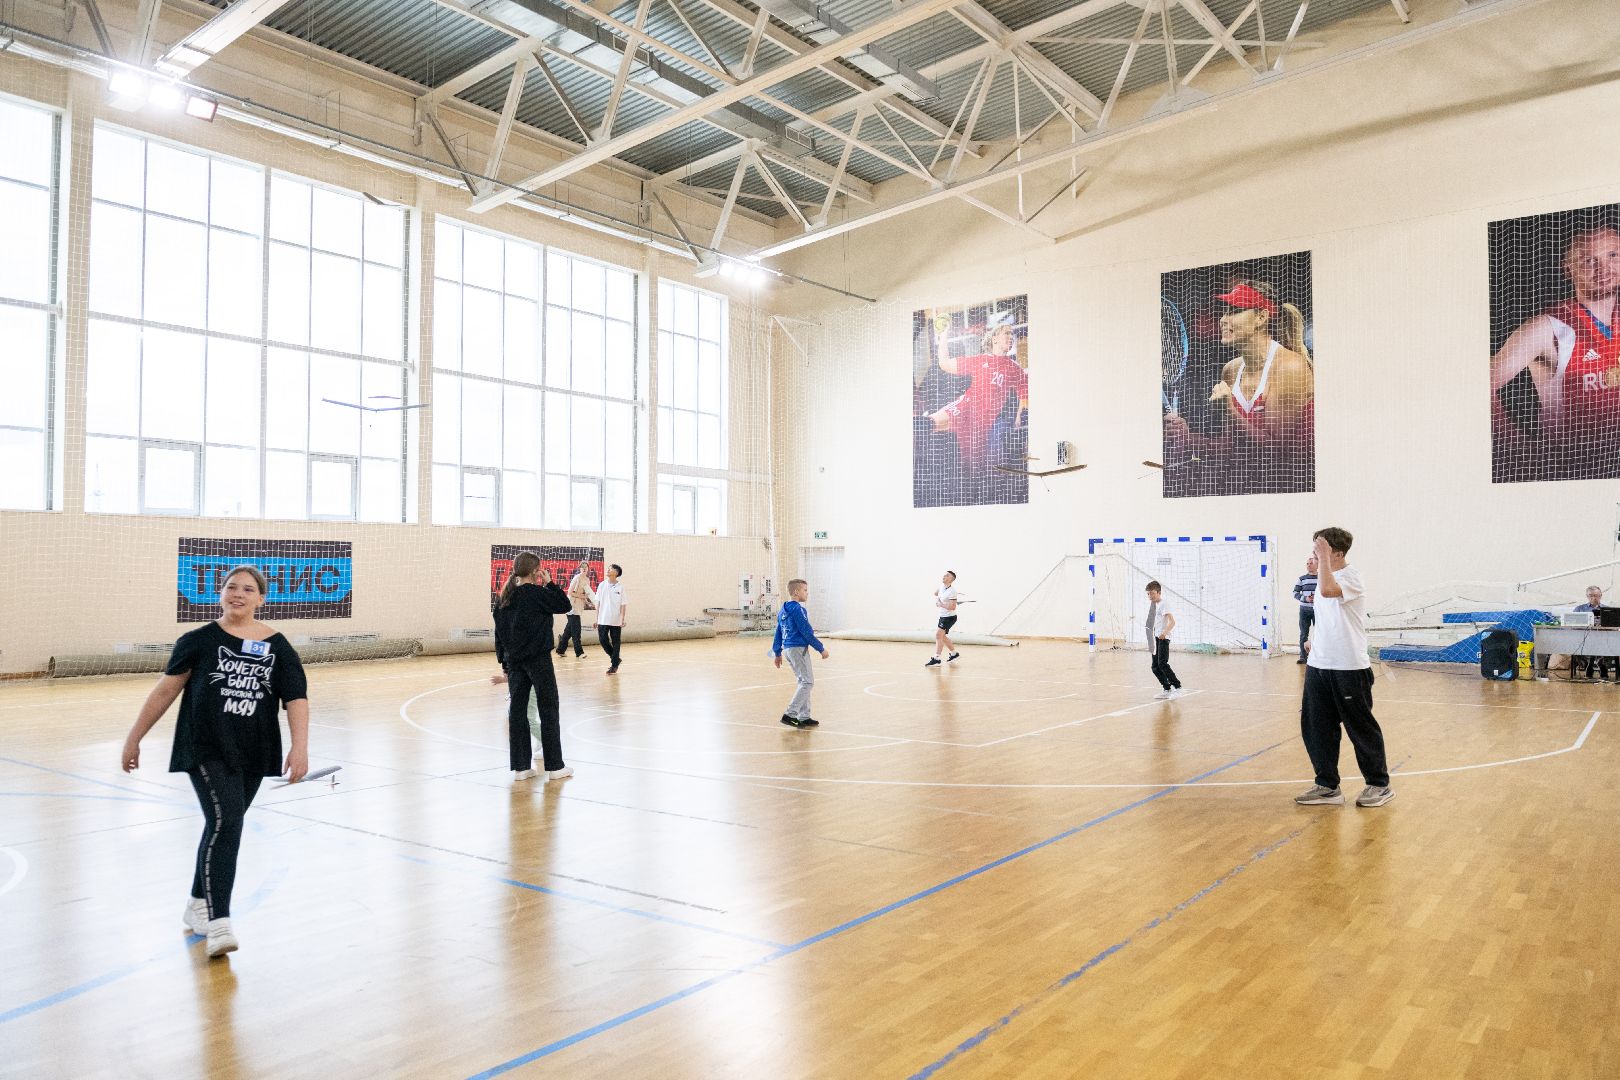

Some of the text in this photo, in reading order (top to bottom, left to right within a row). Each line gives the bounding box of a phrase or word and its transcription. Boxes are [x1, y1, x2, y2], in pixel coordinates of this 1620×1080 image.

[991, 371, 1004, 387] 20
[192, 564, 341, 594] ТЕНИС
[252, 643, 265, 652] 31
[216, 658, 273, 680] ХОЧЕТСЯ
[227, 674, 260, 690] БЫТЬ
